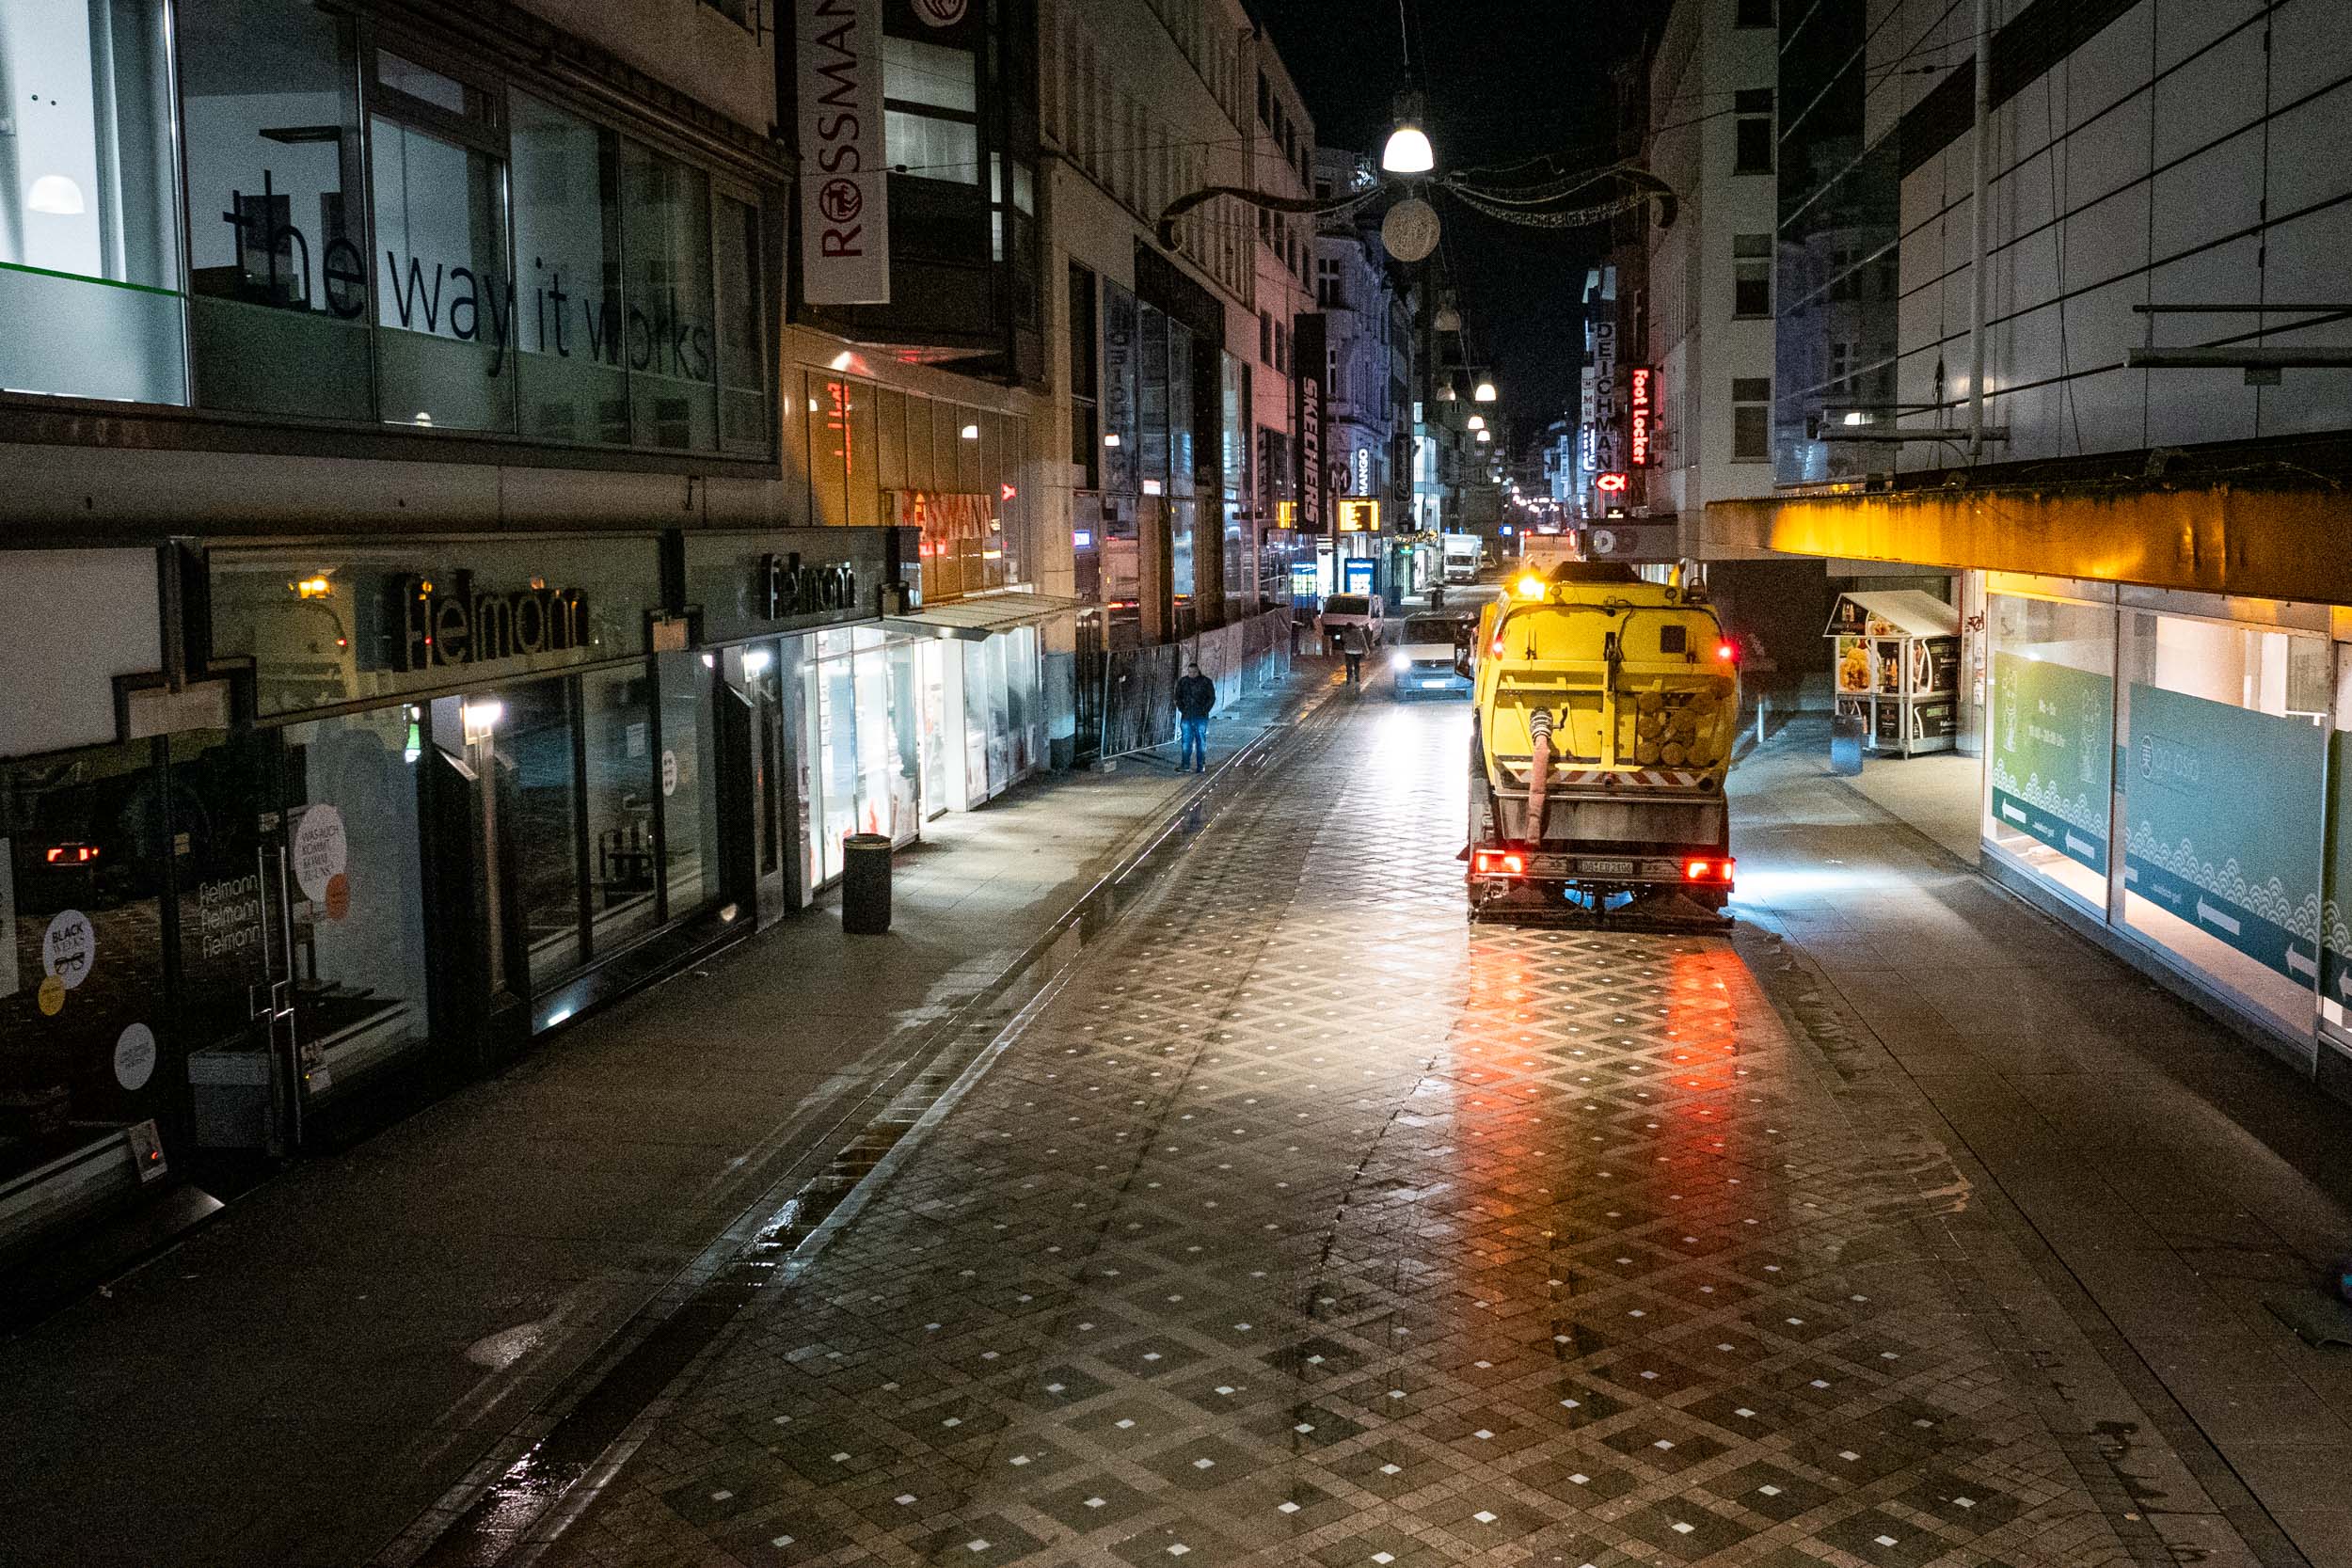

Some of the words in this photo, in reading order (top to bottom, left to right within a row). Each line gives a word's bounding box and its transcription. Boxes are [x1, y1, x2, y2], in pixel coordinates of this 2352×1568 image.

[223, 169, 365, 318] the
[388, 250, 515, 378] way
[535, 256, 569, 358] it
[584, 288, 712, 382] works
[1597, 323, 1613, 469] DEICHMAN
[1632, 369, 1649, 405] Foot
[1303, 375, 1320, 525] SKECHERS
[1632, 410, 1649, 465] Locker
[1358, 448, 1369, 496] MANGO
[52, 922, 84, 943] BLACK
